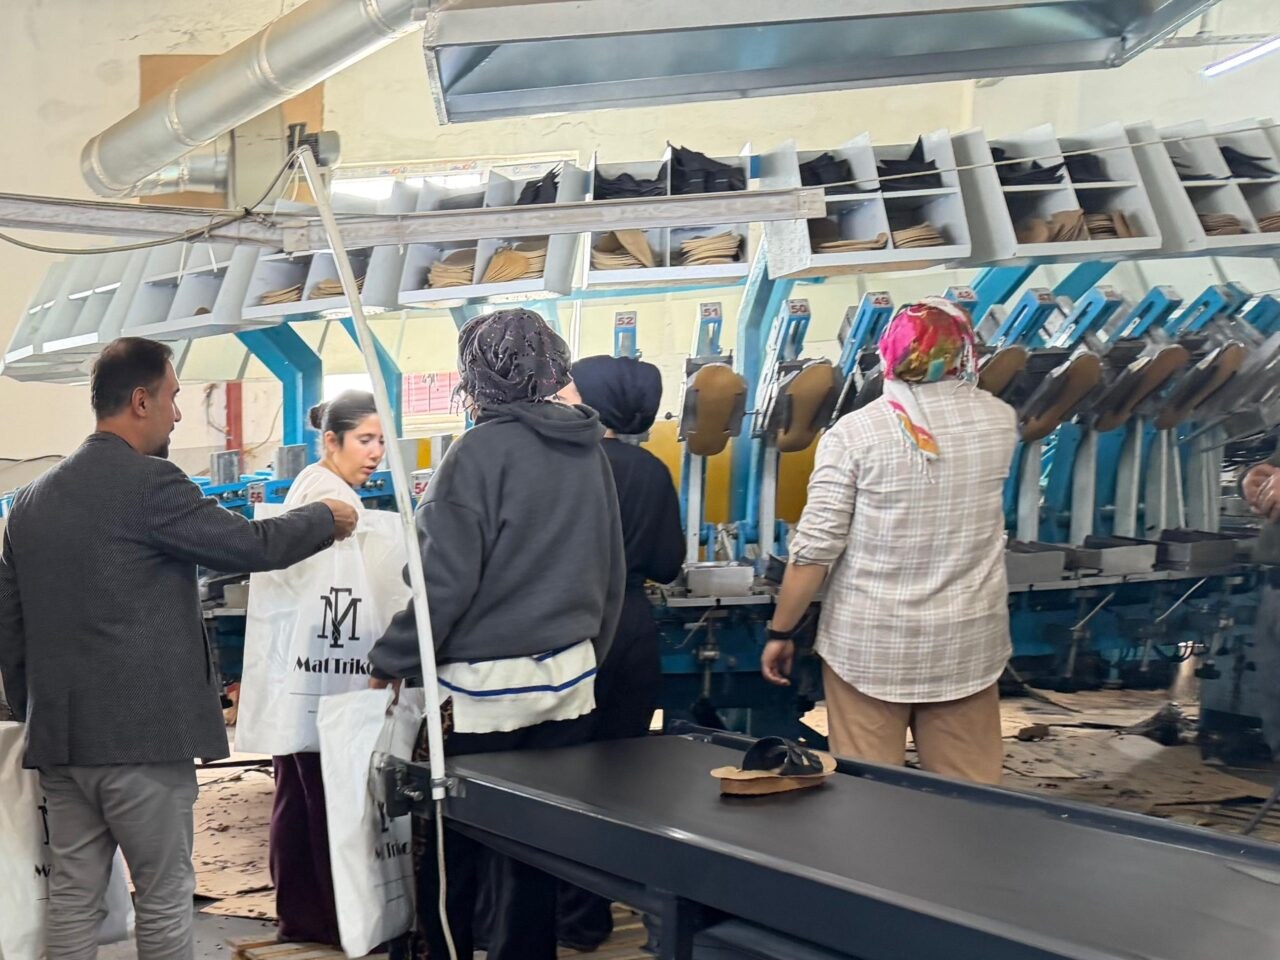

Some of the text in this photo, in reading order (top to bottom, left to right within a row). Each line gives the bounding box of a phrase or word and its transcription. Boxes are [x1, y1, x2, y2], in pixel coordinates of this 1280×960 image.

[703, 308, 719, 317] 51
[791, 304, 807, 314] 50
[617, 316, 634, 326] 52
